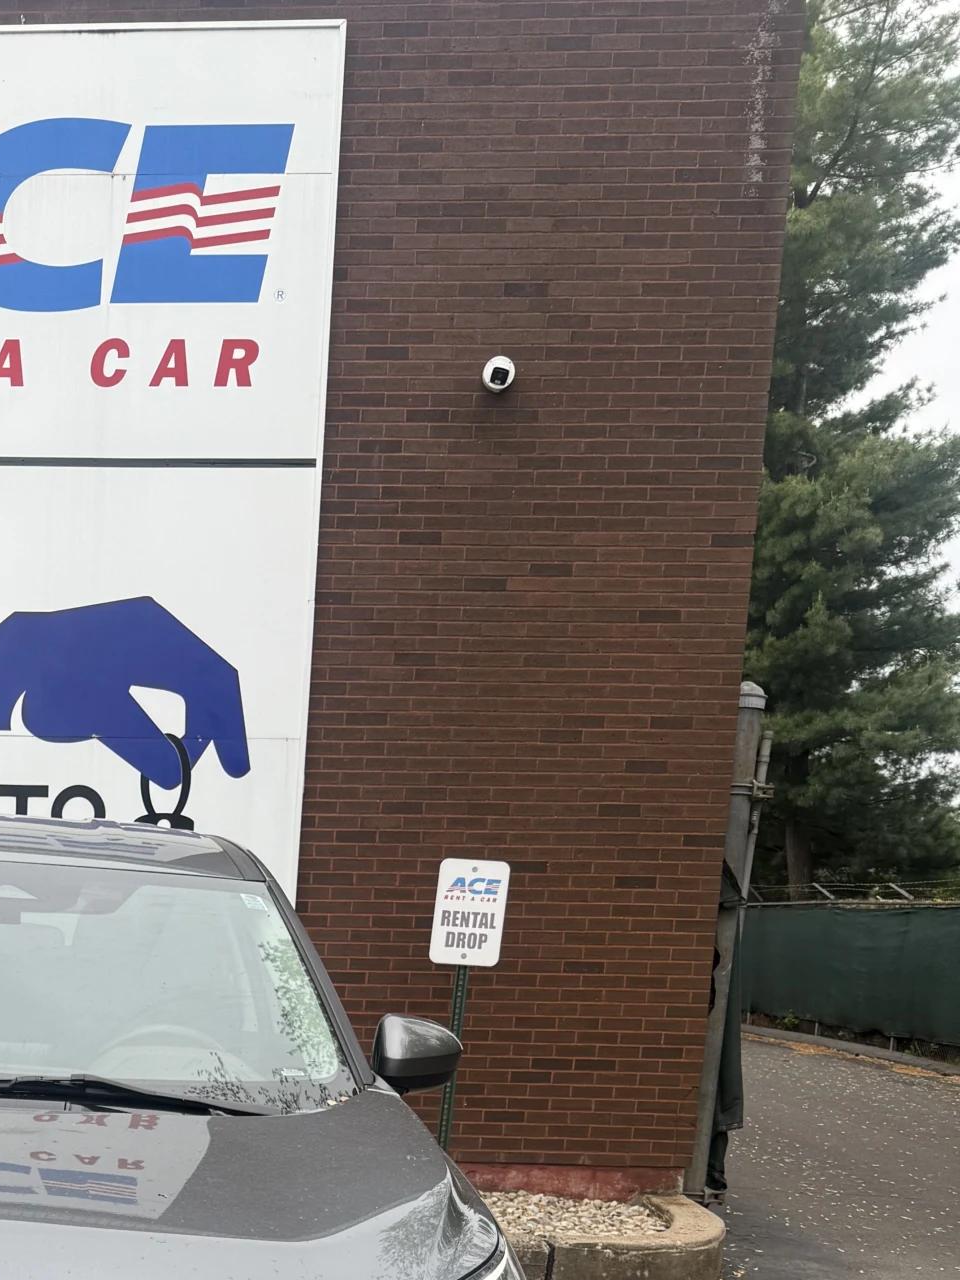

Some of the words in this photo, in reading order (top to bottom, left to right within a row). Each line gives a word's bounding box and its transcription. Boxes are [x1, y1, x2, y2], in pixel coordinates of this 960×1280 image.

[89, 338, 260, 388] CAR
[445, 876, 502, 895] ACE
[440, 909, 497, 929] RENTAL
[444, 931, 488, 949] DROP
